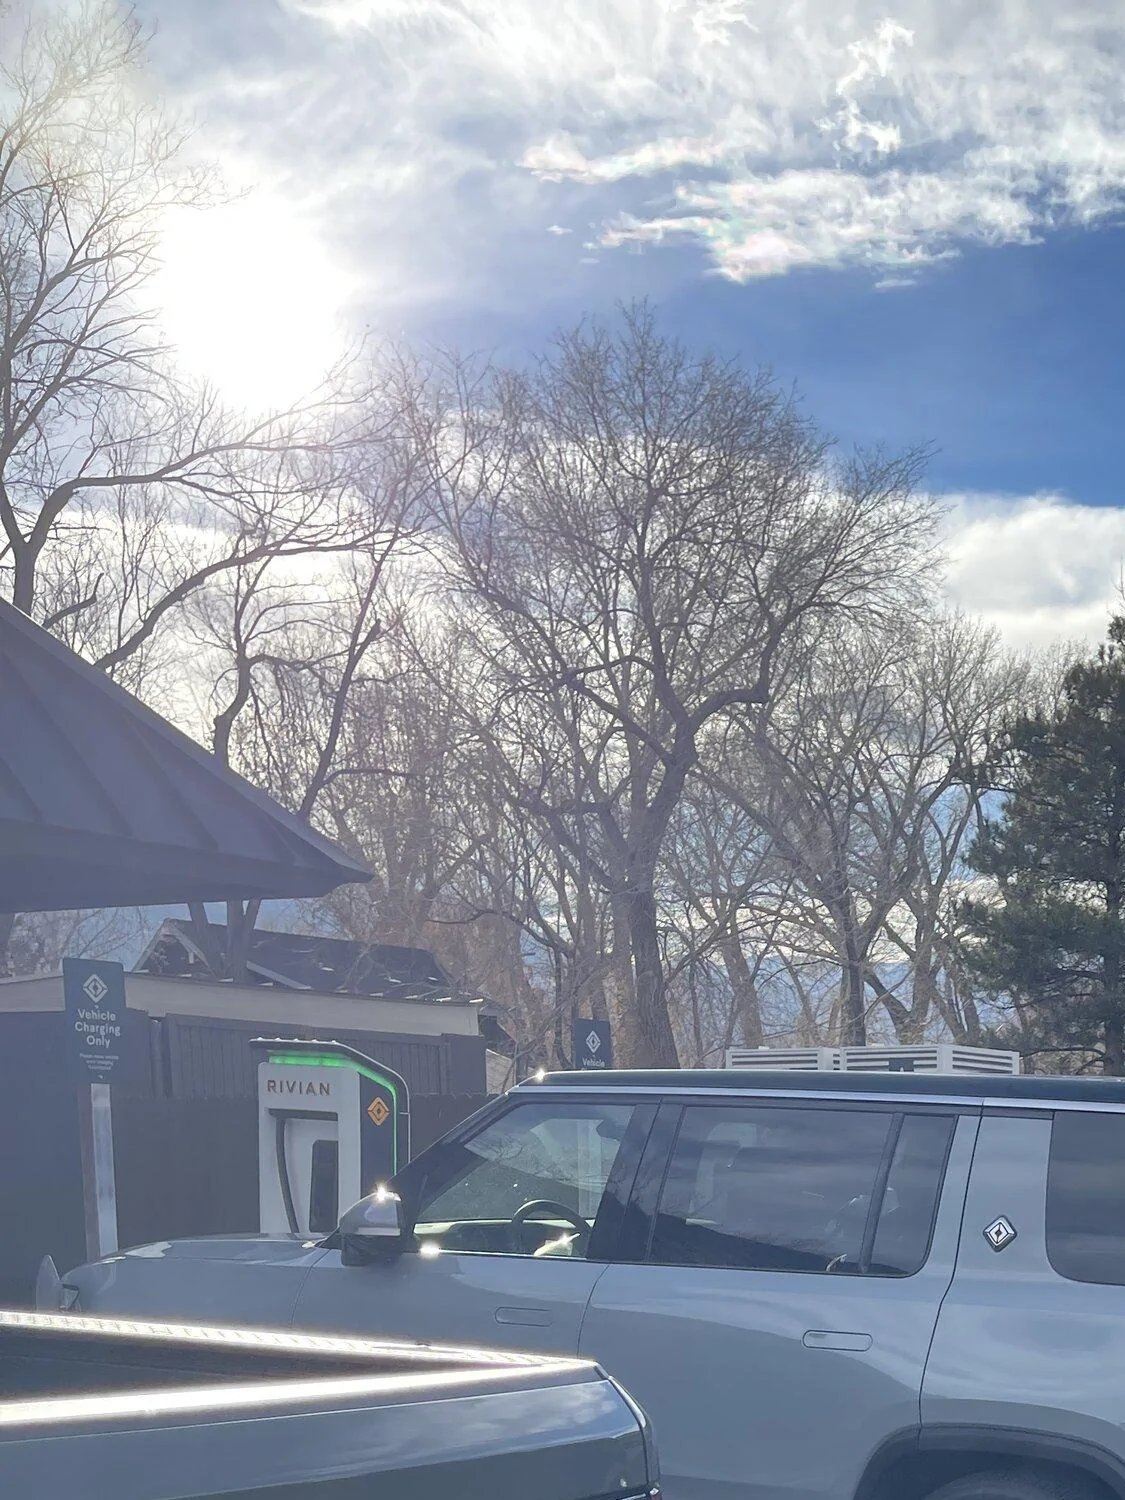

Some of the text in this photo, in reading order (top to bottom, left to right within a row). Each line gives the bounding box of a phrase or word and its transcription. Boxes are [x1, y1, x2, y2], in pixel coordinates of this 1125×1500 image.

[77, 1008, 116, 1021] Vehicle
[74, 1021, 121, 1037] Charging
[86, 1035, 111, 1048] Only
[267, 1079, 331, 1096] RIVIAN
